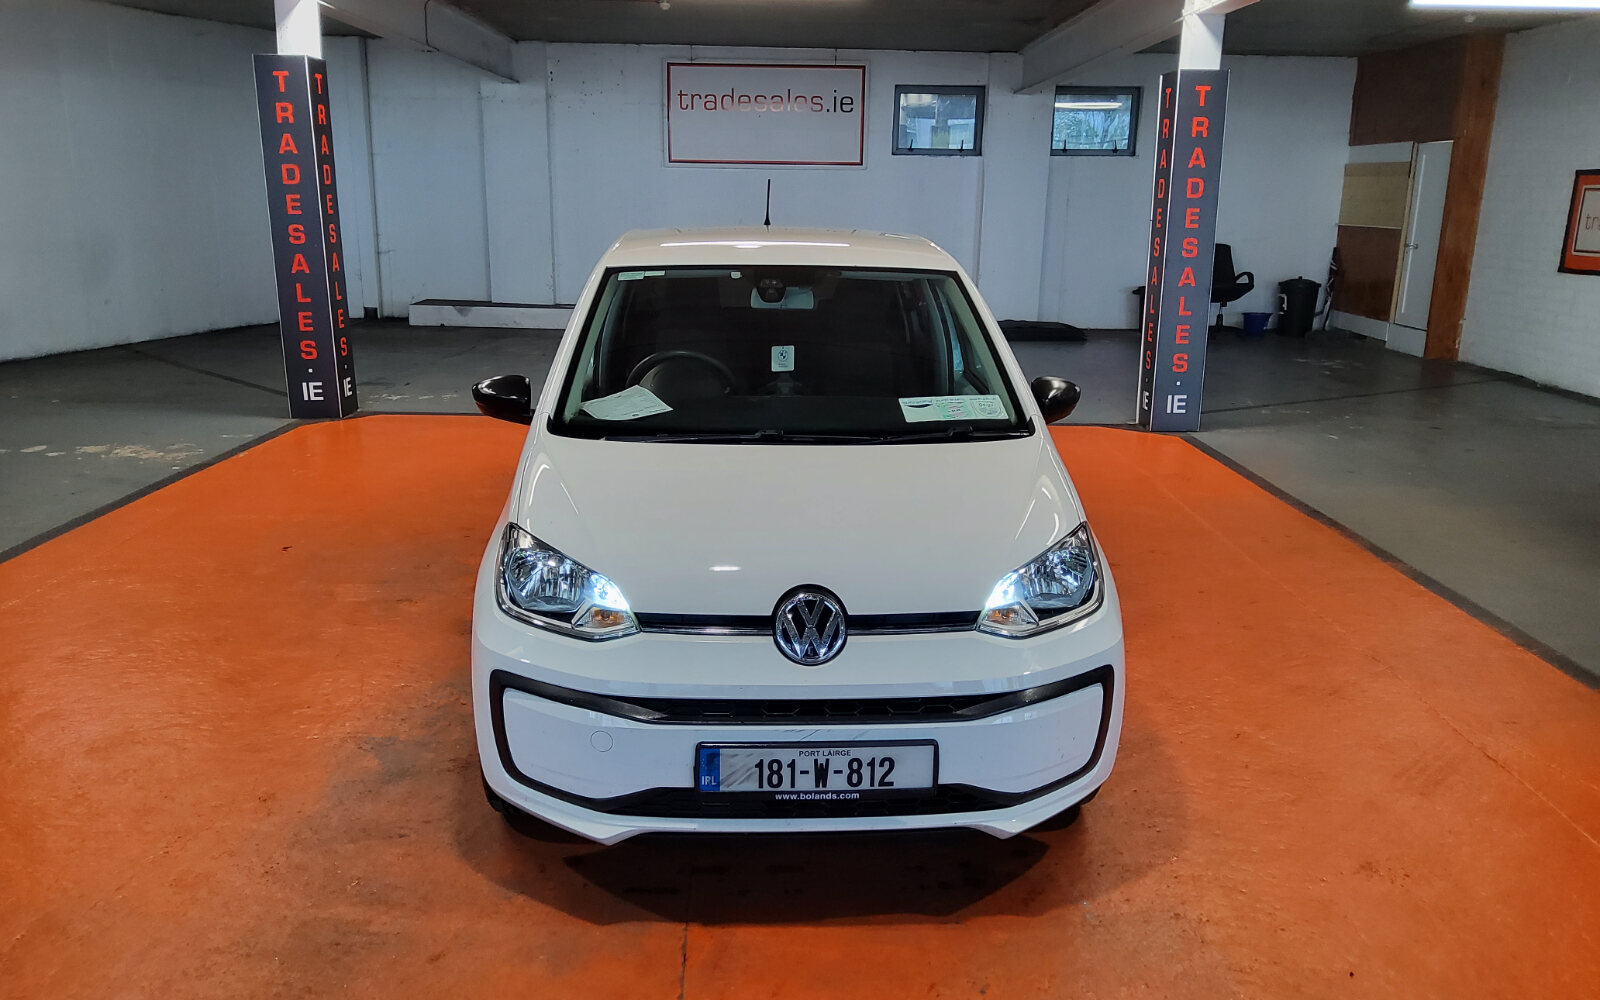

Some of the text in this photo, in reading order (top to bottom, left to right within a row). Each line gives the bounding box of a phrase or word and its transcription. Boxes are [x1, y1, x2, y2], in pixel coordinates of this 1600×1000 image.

[677, 87, 855, 113] tradesales.ie
[1586, 212, 1600, 230] tr
[701, 776, 717, 786] IRL
[754, 757, 896, 789] 181-W-812
[775, 792, 860, 800] www.bolands.com
